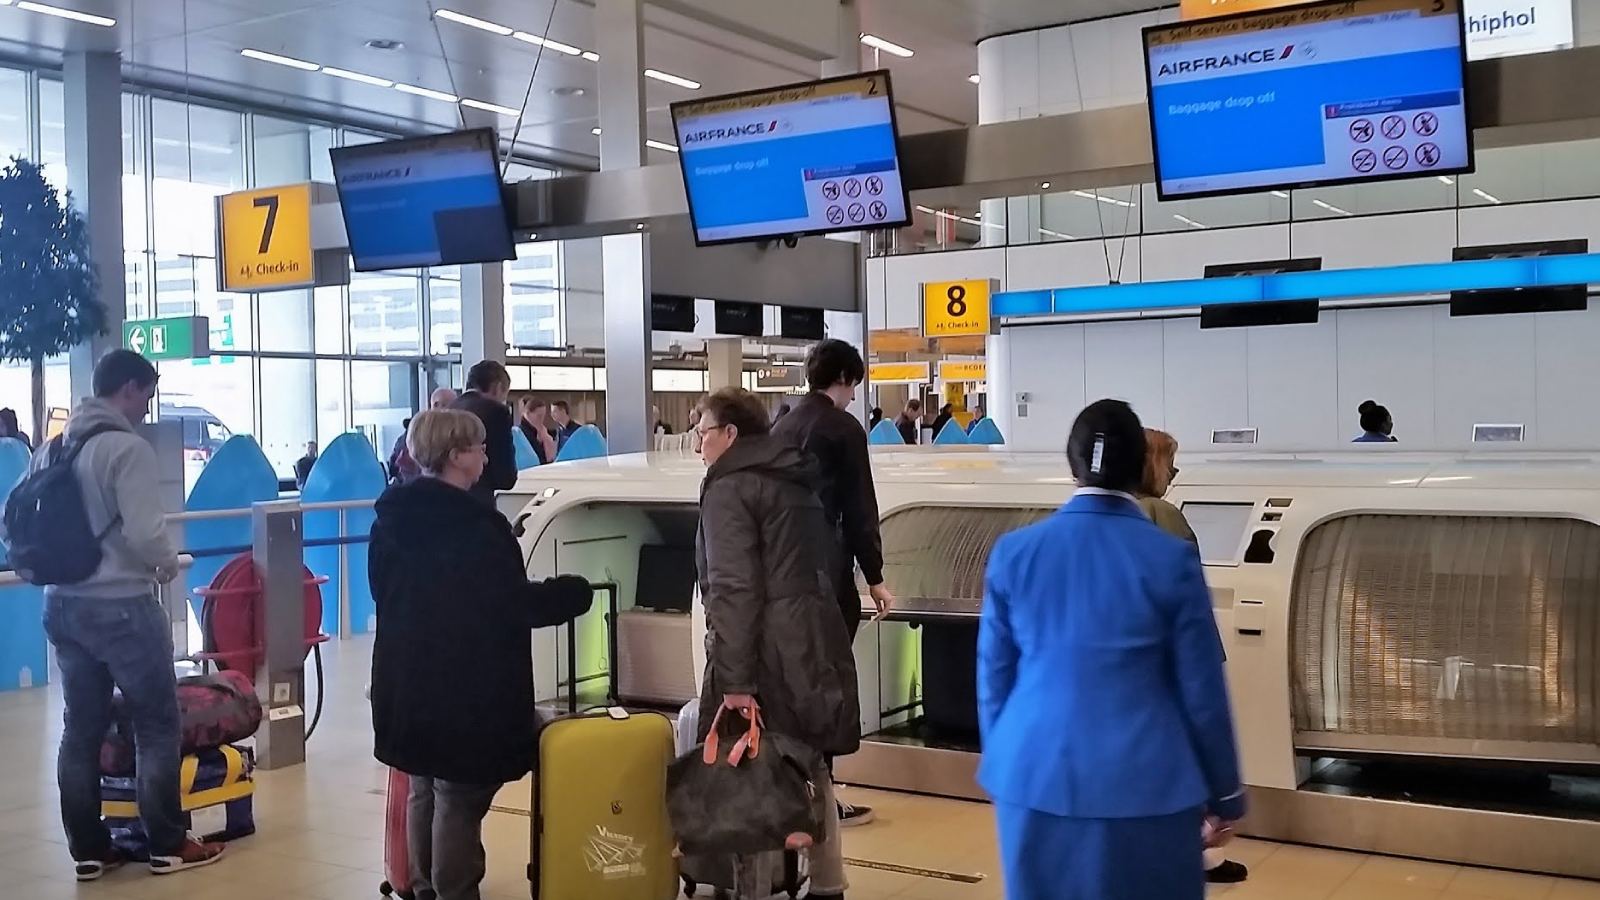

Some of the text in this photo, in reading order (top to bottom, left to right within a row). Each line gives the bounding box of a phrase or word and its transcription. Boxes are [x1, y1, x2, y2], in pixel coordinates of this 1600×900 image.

[1469, 7, 1535, 35] hiphol
[867, 79, 878, 95] 2
[1168, 91, 1275, 116] Baggage drop off
[253, 195, 279, 254] 7
[256, 260, 299, 275] Check-in
[947, 285, 967, 317] 8
